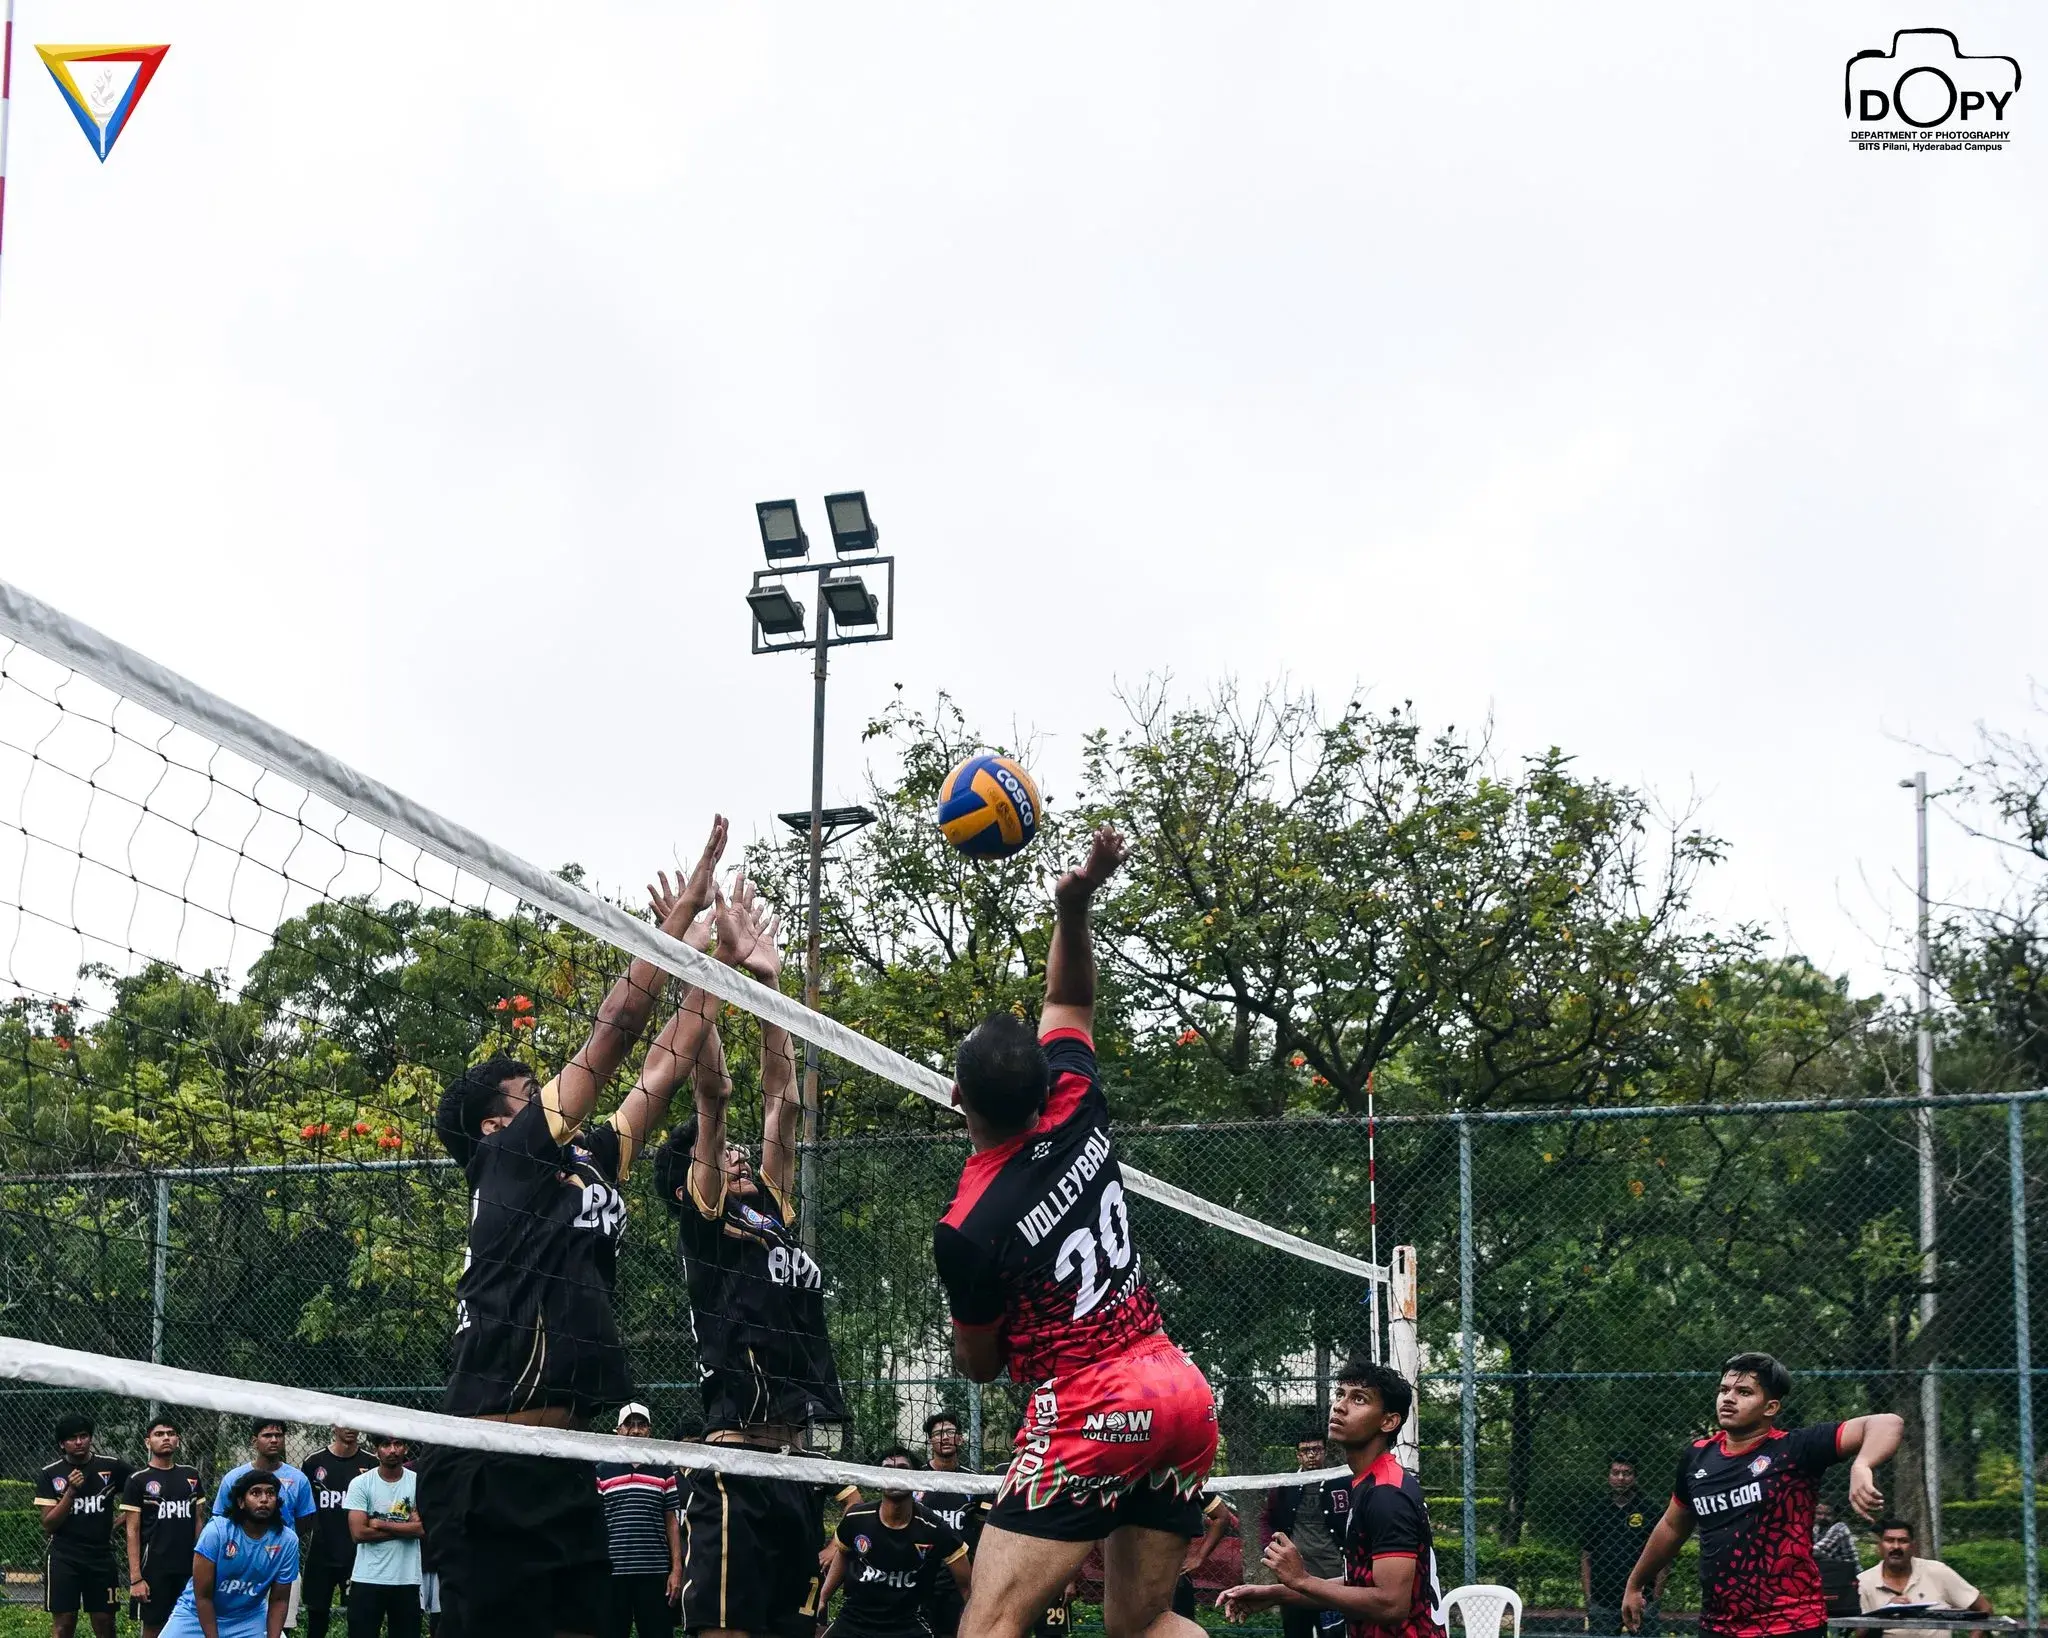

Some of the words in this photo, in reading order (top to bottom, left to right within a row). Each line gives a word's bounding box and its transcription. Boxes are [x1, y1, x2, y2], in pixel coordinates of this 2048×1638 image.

[996, 768, 1034, 827] COSCO
[1054, 1180, 1132, 1321] 20
[1082, 1431, 1151, 1443] VOLLEYBALL
[70, 1494, 106, 1515] PHC
[1692, 1493, 1728, 1516] BITS
[1729, 1481, 1762, 1508] GOA
[1046, 1607, 1065, 1625] 29
